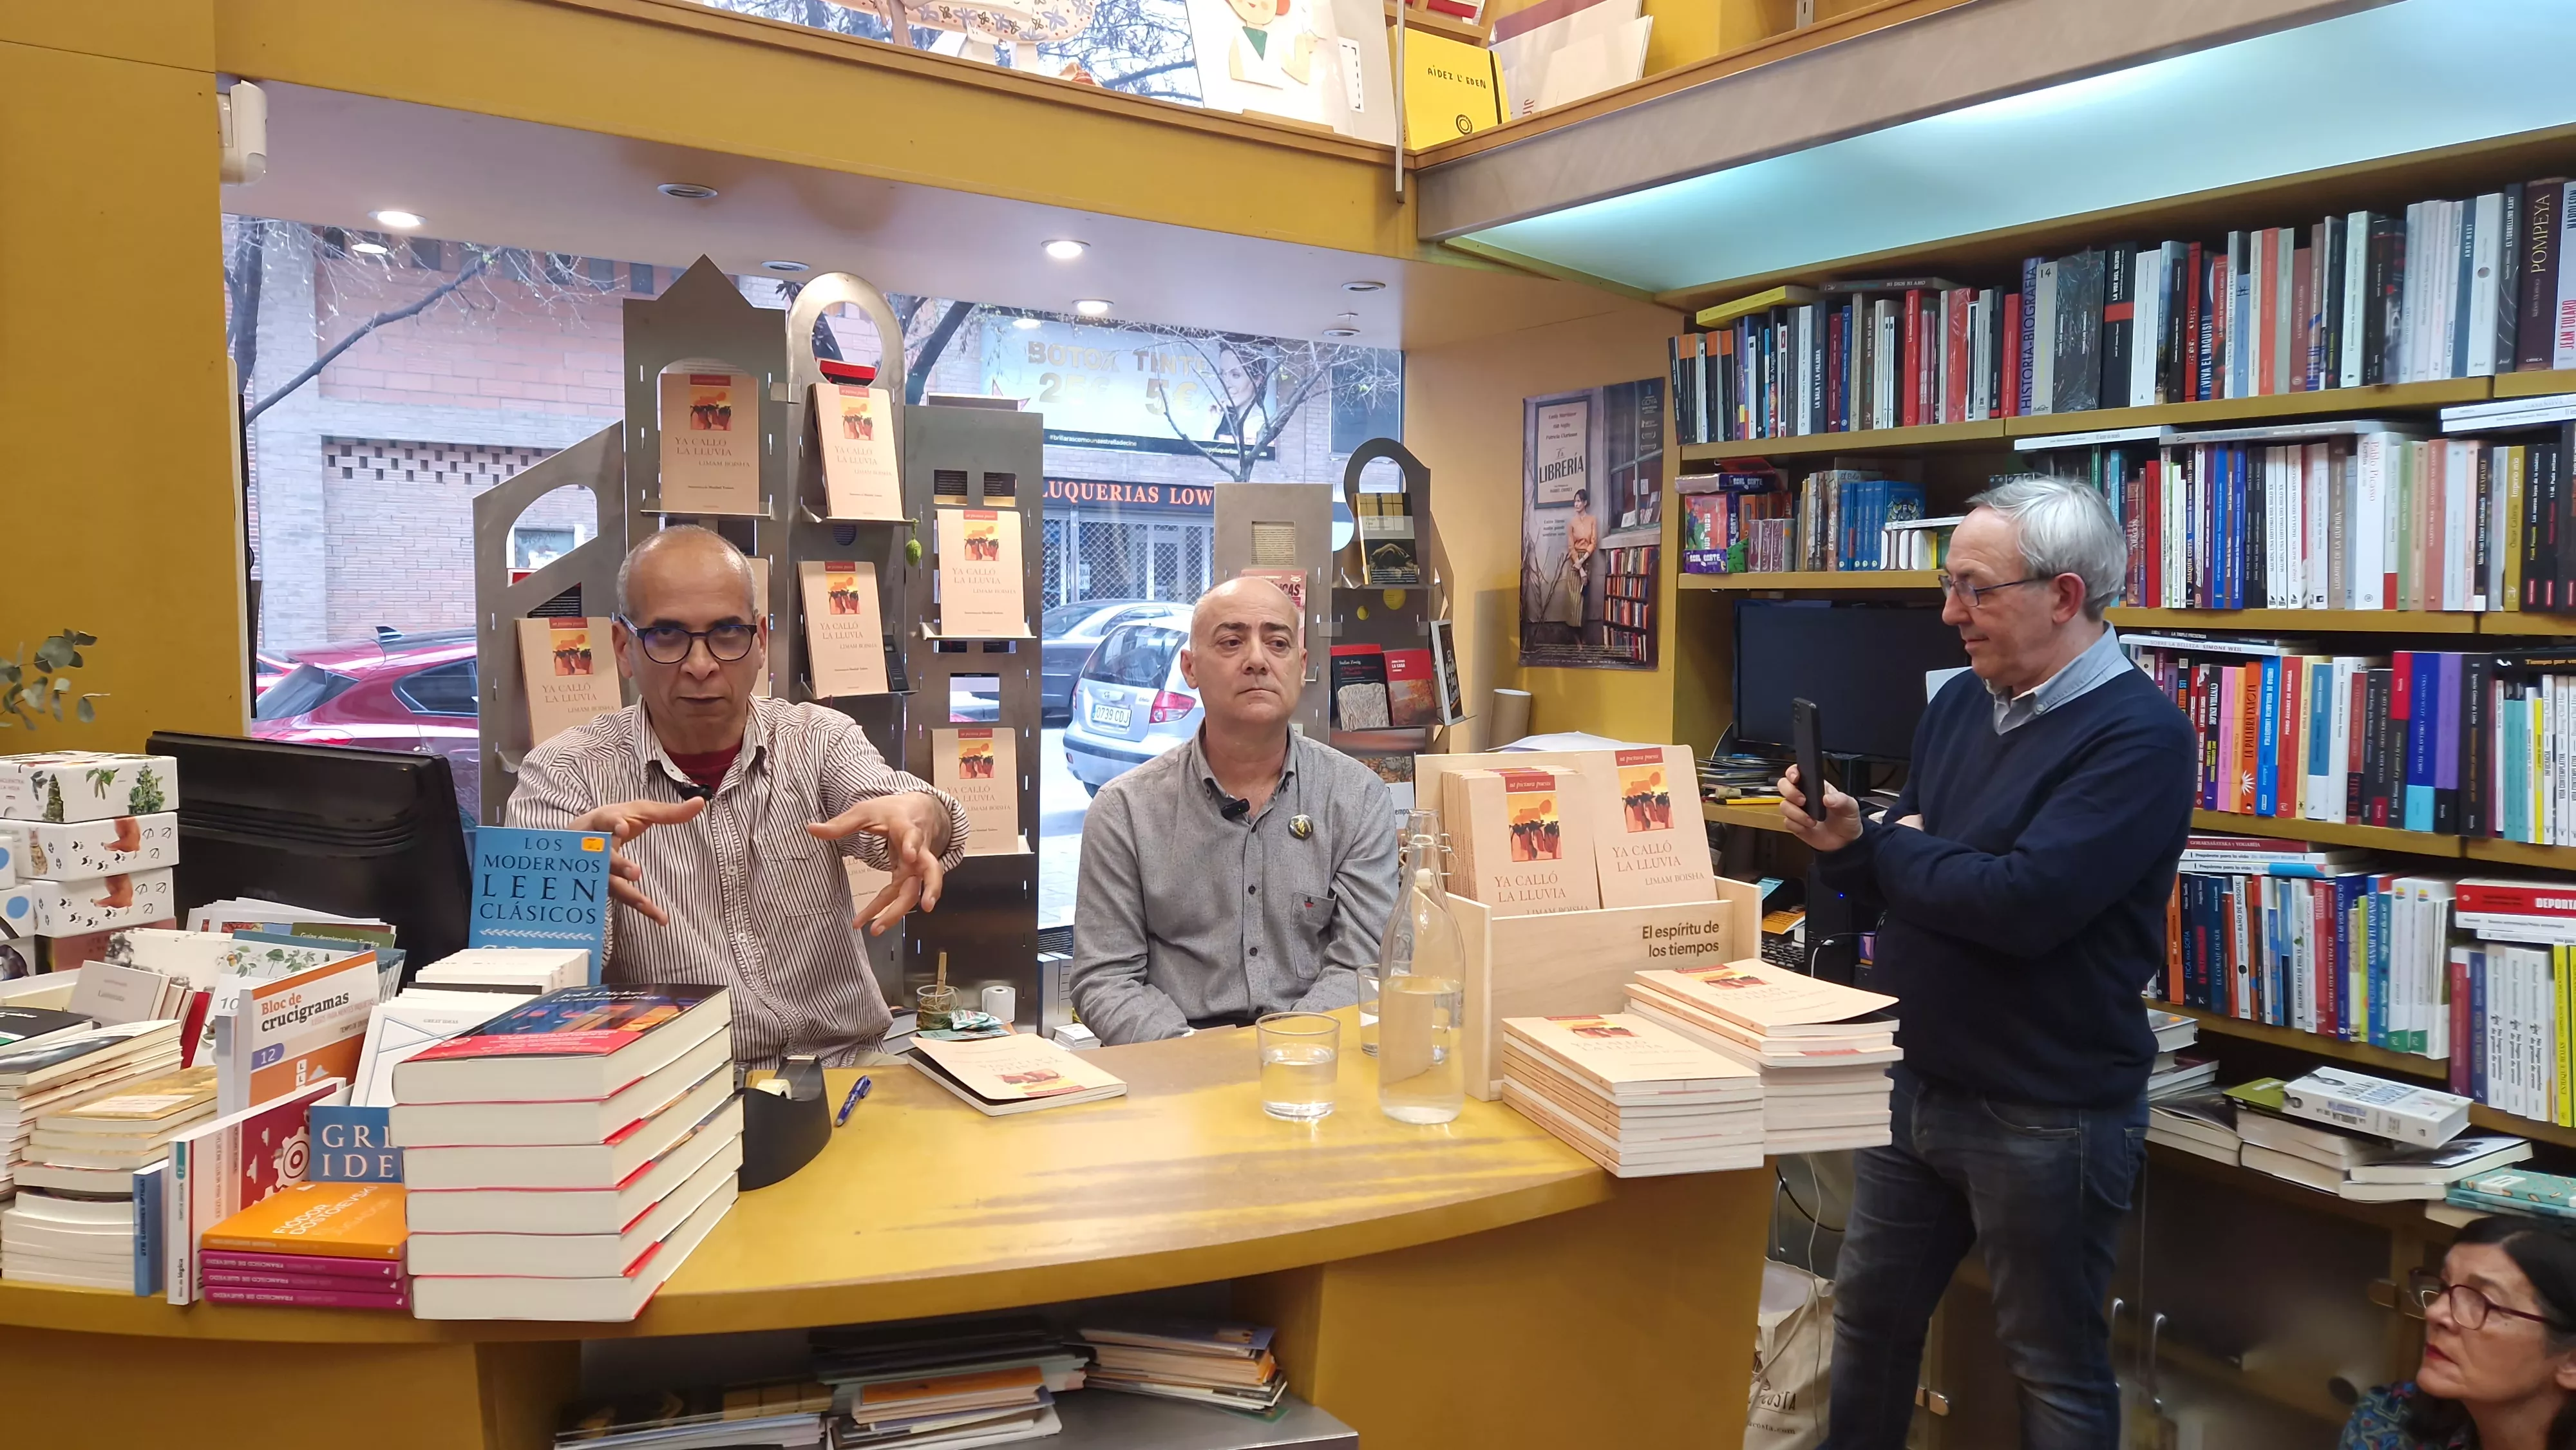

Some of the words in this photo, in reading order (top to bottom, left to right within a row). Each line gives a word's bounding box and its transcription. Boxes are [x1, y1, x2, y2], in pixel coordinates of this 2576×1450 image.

[1466, 76, 1486, 89] EDEN
[2530, 194, 2550, 273] POMPEYA
[2040, 268, 2052, 279] 14
[2560, 300, 2576, 330] TULARD
[2201, 323, 2213, 354] MAQUIS!
[2559, 331, 2576, 350] JEAN
[1028, 341, 1119, 372] BOTOX
[1132, 350, 1213, 377] TINTE
[2201, 356, 2211, 366] EL
[2200, 368, 2212, 388] ¡VIVA
[694, 447, 732, 456] LLUVIA
[849, 456, 877, 465] LLUVIA
[2369, 441, 2380, 466] Pablo
[1539, 453, 1584, 483] LIBRERÍA
[2369, 469, 2379, 502] Picasso
[2511, 472, 2521, 497] Imperio
[1169, 487, 1214, 506] LOW
[2334, 540, 2341, 549] LA
[542, 684, 555, 693] YA
[562, 693, 597, 702] LLUVIA
[2209, 683, 2218, 707] CYNTHIA
[2208, 706, 2217, 725] ENLOE
[2244, 717, 2255, 748] PALABRA
[2244, 750, 2253, 758] LA
[524, 837, 562, 852] LOS
[1612, 847, 1629, 858] YA
[1631, 841, 1672, 856] CALLÓ
[483, 854, 601, 874] MODERNOS
[1616, 862, 1633, 872] LA
[1636, 856, 1681, 870] LLUVIA
[482, 873, 597, 903] LEEN
[1493, 876, 1511, 889] YA
[1515, 871, 1558, 887] CALLÓ
[1645, 876, 1672, 885] LIMAM
[1674, 872, 1705, 882] BOISHA
[2338, 884, 2344, 892] YO
[1498, 890, 1516, 903] LA
[1519, 888, 1566, 901] LLUVIA
[479, 901, 596, 925] CLÁSICOS
[2368, 892, 2377, 927] INFANCIA
[1642, 925, 1653, 939] El
[1655, 922, 1701, 940] espíritu
[1703, 920, 1719, 934] de
[2183, 930, 2191, 949] SOFÍA
[2338, 933, 2344, 942] EN
[2369, 927, 2376, 937] TU
[1649, 944, 1667, 957] los
[1669, 941, 1719, 957] tiempos
[2215, 942, 2221, 950] DE
[261, 1001, 286, 1016] Bloc
[288, 993, 302, 1006] de
[261, 990, 350, 1032] crucigramas
[260, 1048, 276, 1062] 12
